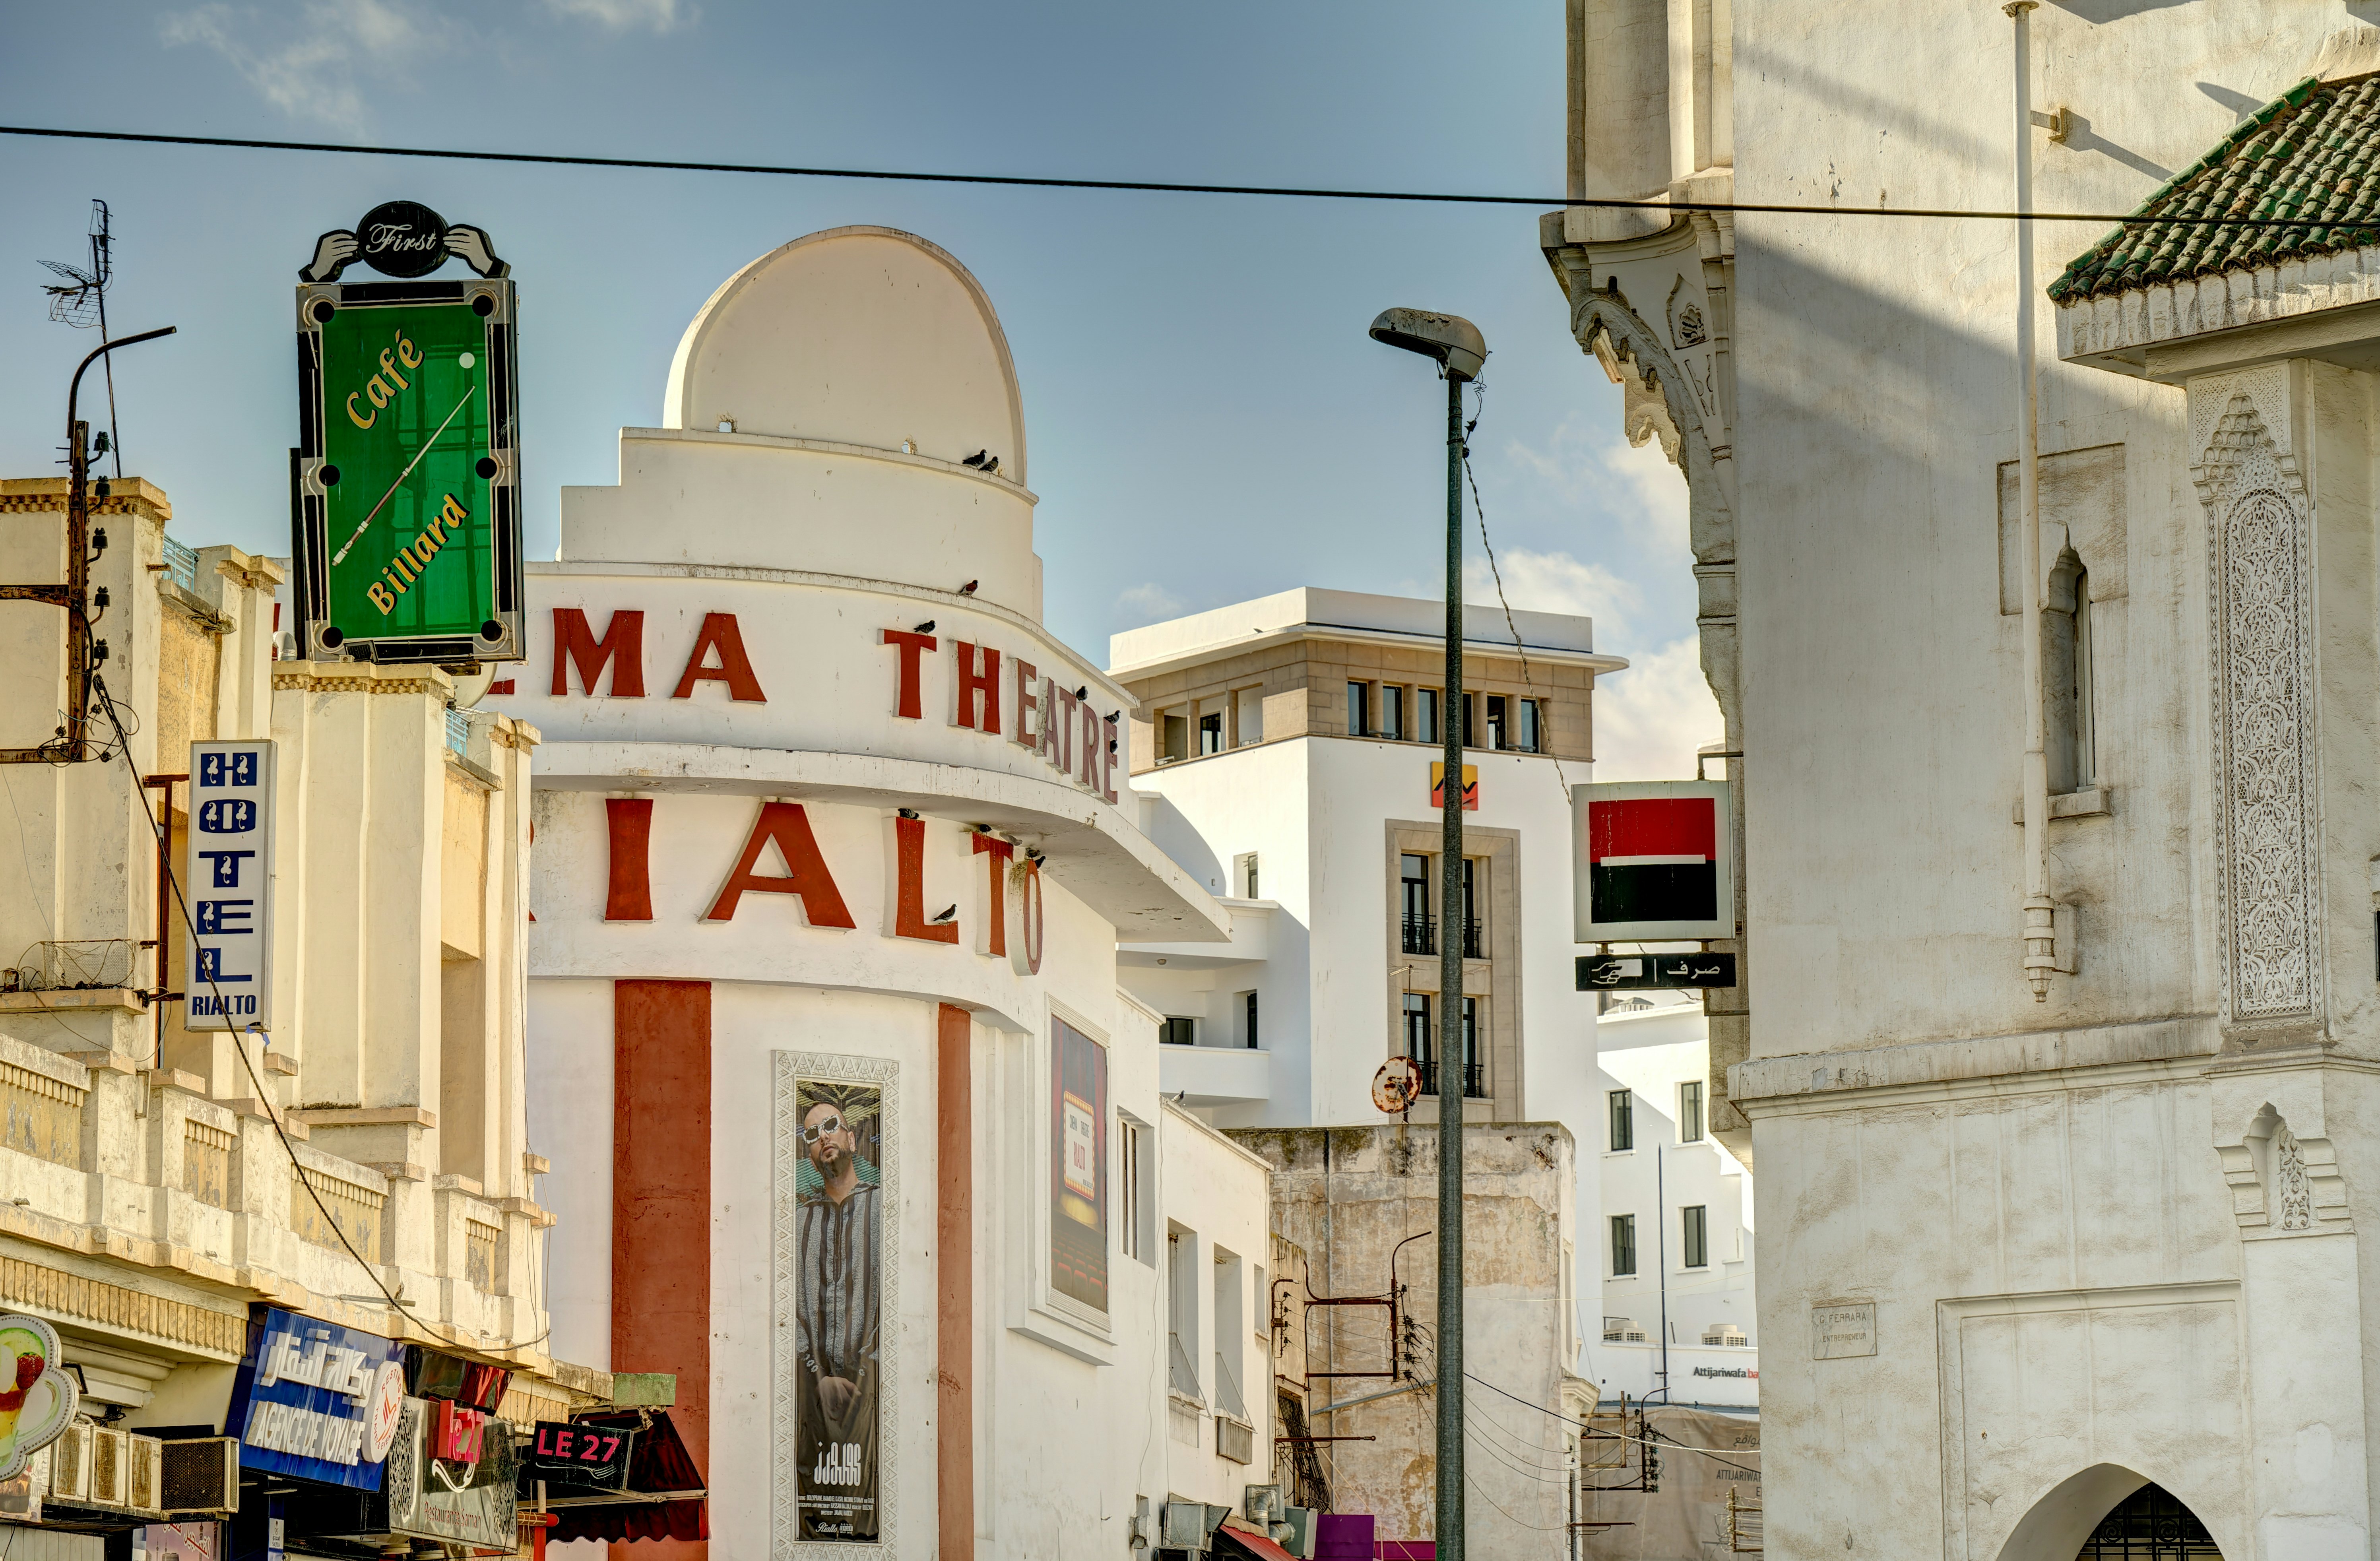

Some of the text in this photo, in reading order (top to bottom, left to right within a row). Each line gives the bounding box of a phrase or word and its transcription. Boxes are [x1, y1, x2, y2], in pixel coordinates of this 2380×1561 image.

[366, 223, 436, 253] First
[346, 329, 425, 430] Café
[367, 493, 470, 616] Billard
[877, 628, 1118, 805] THEATRE
[195, 752, 258, 983] HOTEL
[528, 798, 1043, 977] IALTO
[1667, 960, 1721, 979] صرف
[192, 995, 256, 1016] RIALTO
[1073, 1141, 1086, 1171] RIALTO
[1829, 1312, 1867, 1323] FERRARA
[1823, 1332, 1866, 1342] ENTREPRENEUR
[260, 1329, 375, 1408] وكالة أسفار
[1693, 1367, 1746, 1379] Attijariwafa
[382, 1368, 402, 1405] RESTINGA
[254, 1401, 366, 1466] AGENCE DE VOYAGE
[537, 1429, 620, 1462] LE 27
[424, 1501, 460, 1526] Restaurante
[815, 1522, 838, 1533] Rialto
